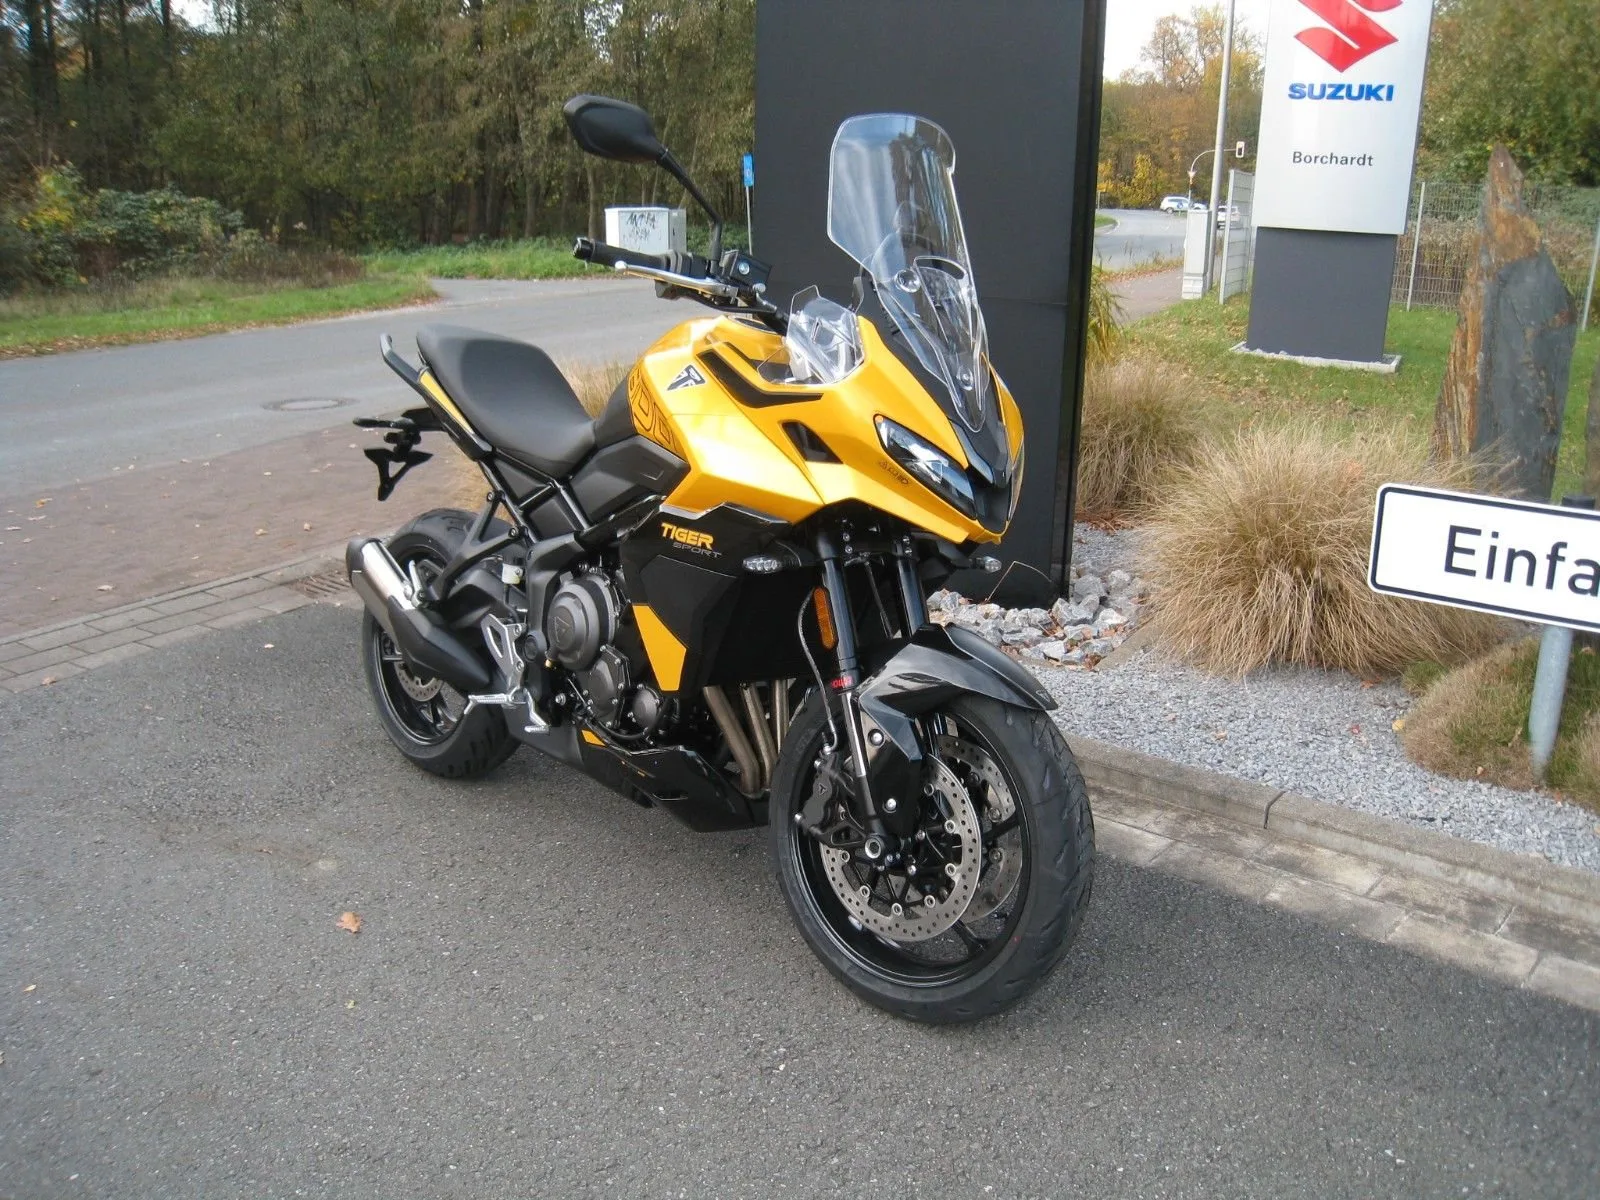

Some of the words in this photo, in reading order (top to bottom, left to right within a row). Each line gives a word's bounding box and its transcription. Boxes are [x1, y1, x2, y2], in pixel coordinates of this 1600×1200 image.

[1288, 83, 1394, 101] SUZUKI
[1292, 151, 1374, 166] Borchardt
[661, 522, 714, 550] TIGER
[673, 541, 722, 558] SPORT
[1444, 524, 1600, 597] Einfa
